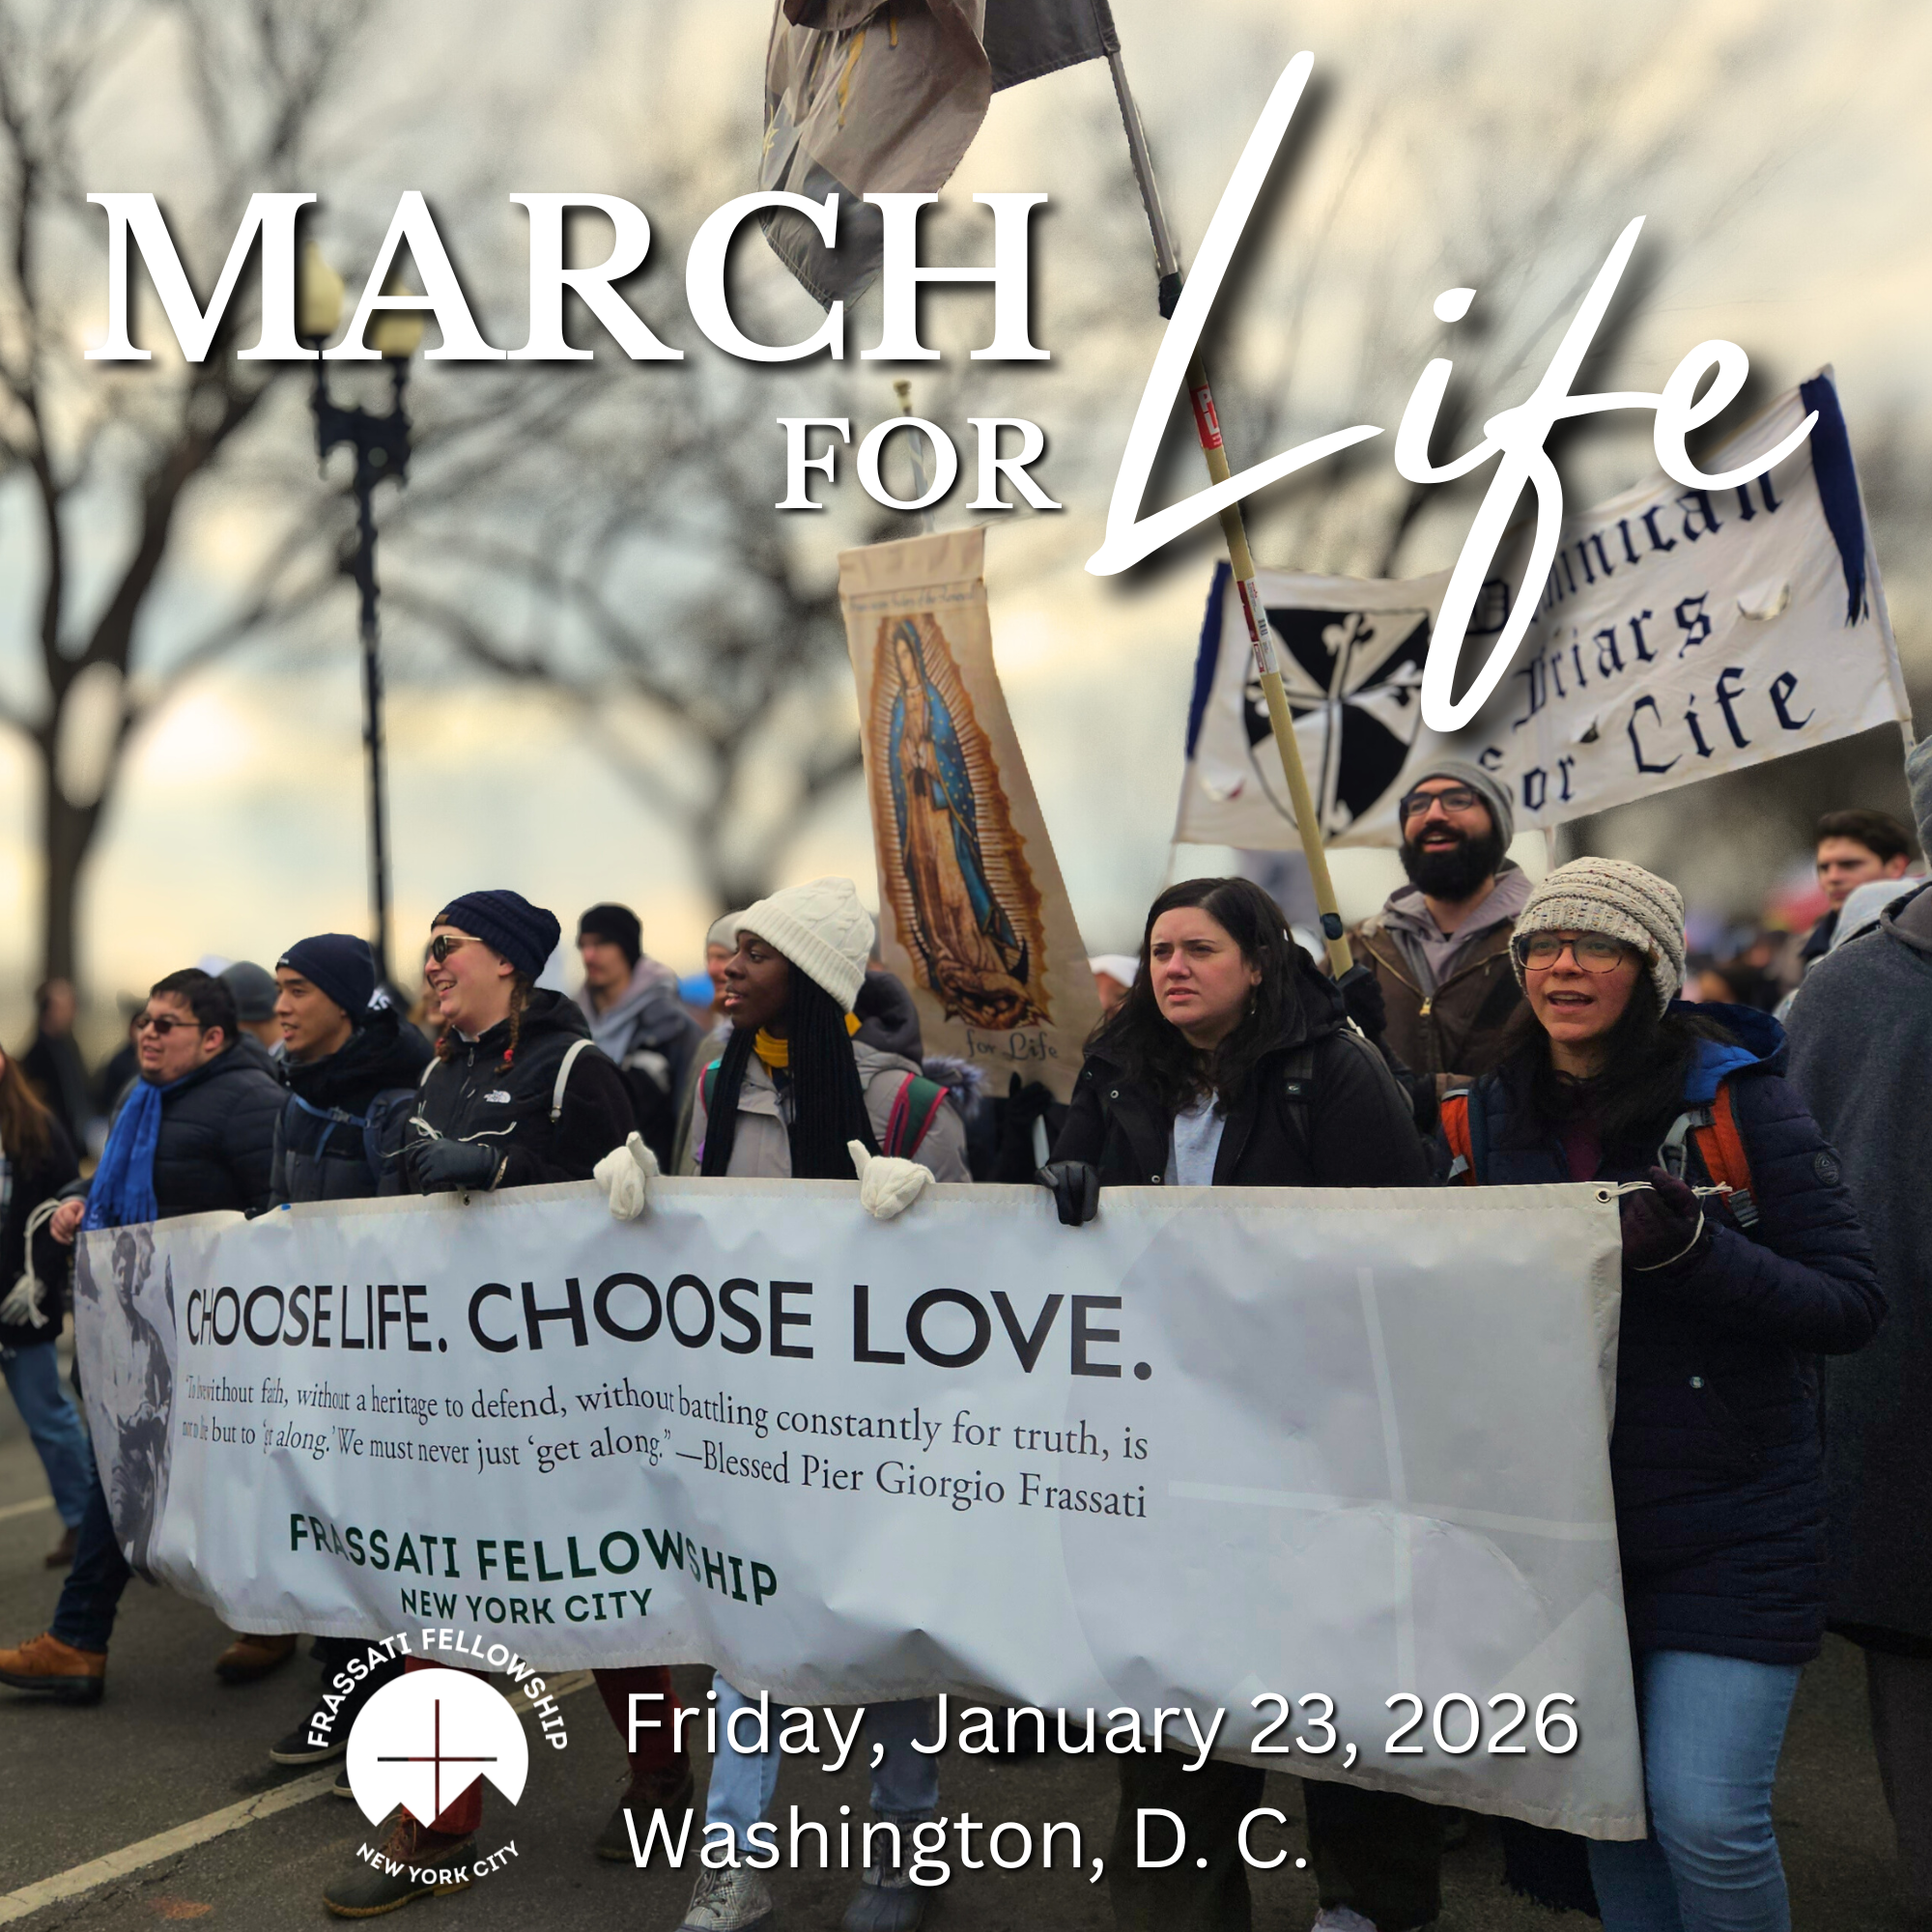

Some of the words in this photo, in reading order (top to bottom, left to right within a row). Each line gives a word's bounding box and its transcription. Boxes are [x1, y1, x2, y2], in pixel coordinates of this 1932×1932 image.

[1466, 470, 1783, 636] Dminican
[1511, 591, 1713, 733] Friars
[1627, 667, 1816, 774] Life
[967, 1029, 996, 1058] for
[1003, 1031, 1059, 1061] Life
[187, 1285, 333, 1348] CHOOSE
[341, 1284, 448, 1352] LIFE.
[469, 1272, 814, 1359] CHOOSE
[853, 1284, 1152, 1380] LOVE.
[212, 1416, 237, 1443] but
[241, 1426, 256, 1445] to
[338, 1427, 363, 1457] We
[369, 1437, 413, 1461] must
[417, 1441, 469, 1464] never
[477, 1438, 521, 1474] just
[802, 1454, 864, 1492] Pier
[875, 1460, 1005, 1512] Giorgio
[1019, 1472, 1147, 1519] Frassati
[297, 1381, 351, 1411] without
[355, 1394, 367, 1411] a
[372, 1384, 439, 1426] heritage
[444, 1393, 464, 1419] to
[470, 1384, 568, 1420] defend,
[576, 1378, 674, 1413] without
[678, 1384, 769, 1439] battling
[776, 1406, 942, 1453] constantly
[952, 1409, 1002, 1449] for
[1012, 1419, 1110, 1462] truth,
[1122, 1426, 1149, 1461] is
[291, 1513, 460, 1578] FRASSATI
[477, 1526, 777, 1606] FELLOWSHIP
[401, 1588, 458, 1622] NEW
[466, 1597, 554, 1625] YORK
[565, 1588, 652, 1623] CITY
